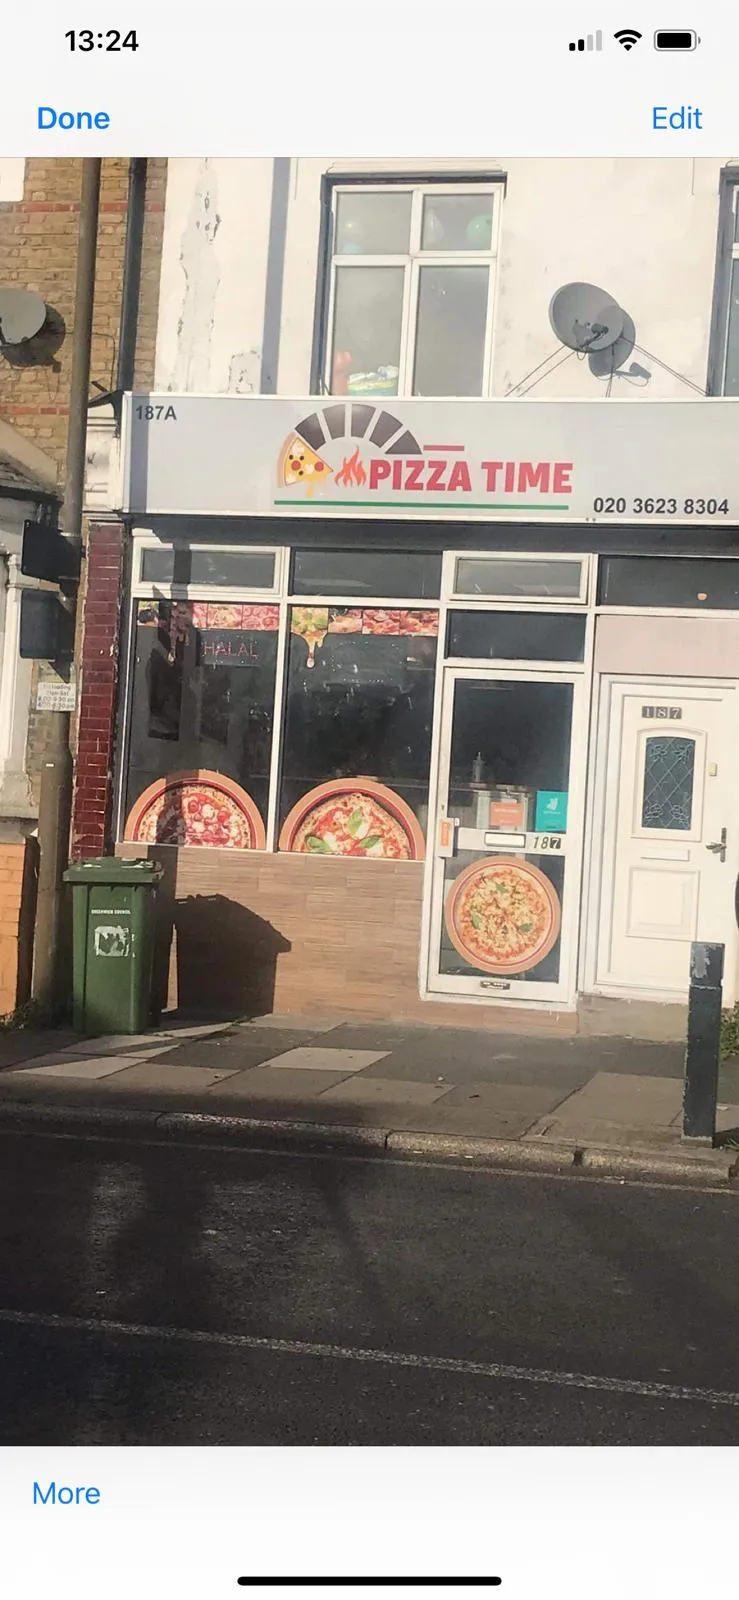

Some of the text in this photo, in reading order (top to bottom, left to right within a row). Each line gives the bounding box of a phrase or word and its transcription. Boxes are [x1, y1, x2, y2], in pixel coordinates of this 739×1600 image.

[135, 405, 177, 421] 187A
[369, 459, 573, 494] PIZZA TIME
[592, 497, 730, 516] 020 3623 8304
[203, 641, 258, 658] HALAL
[641, 706, 682, 719] 187
[533, 836, 561, 849] 187
